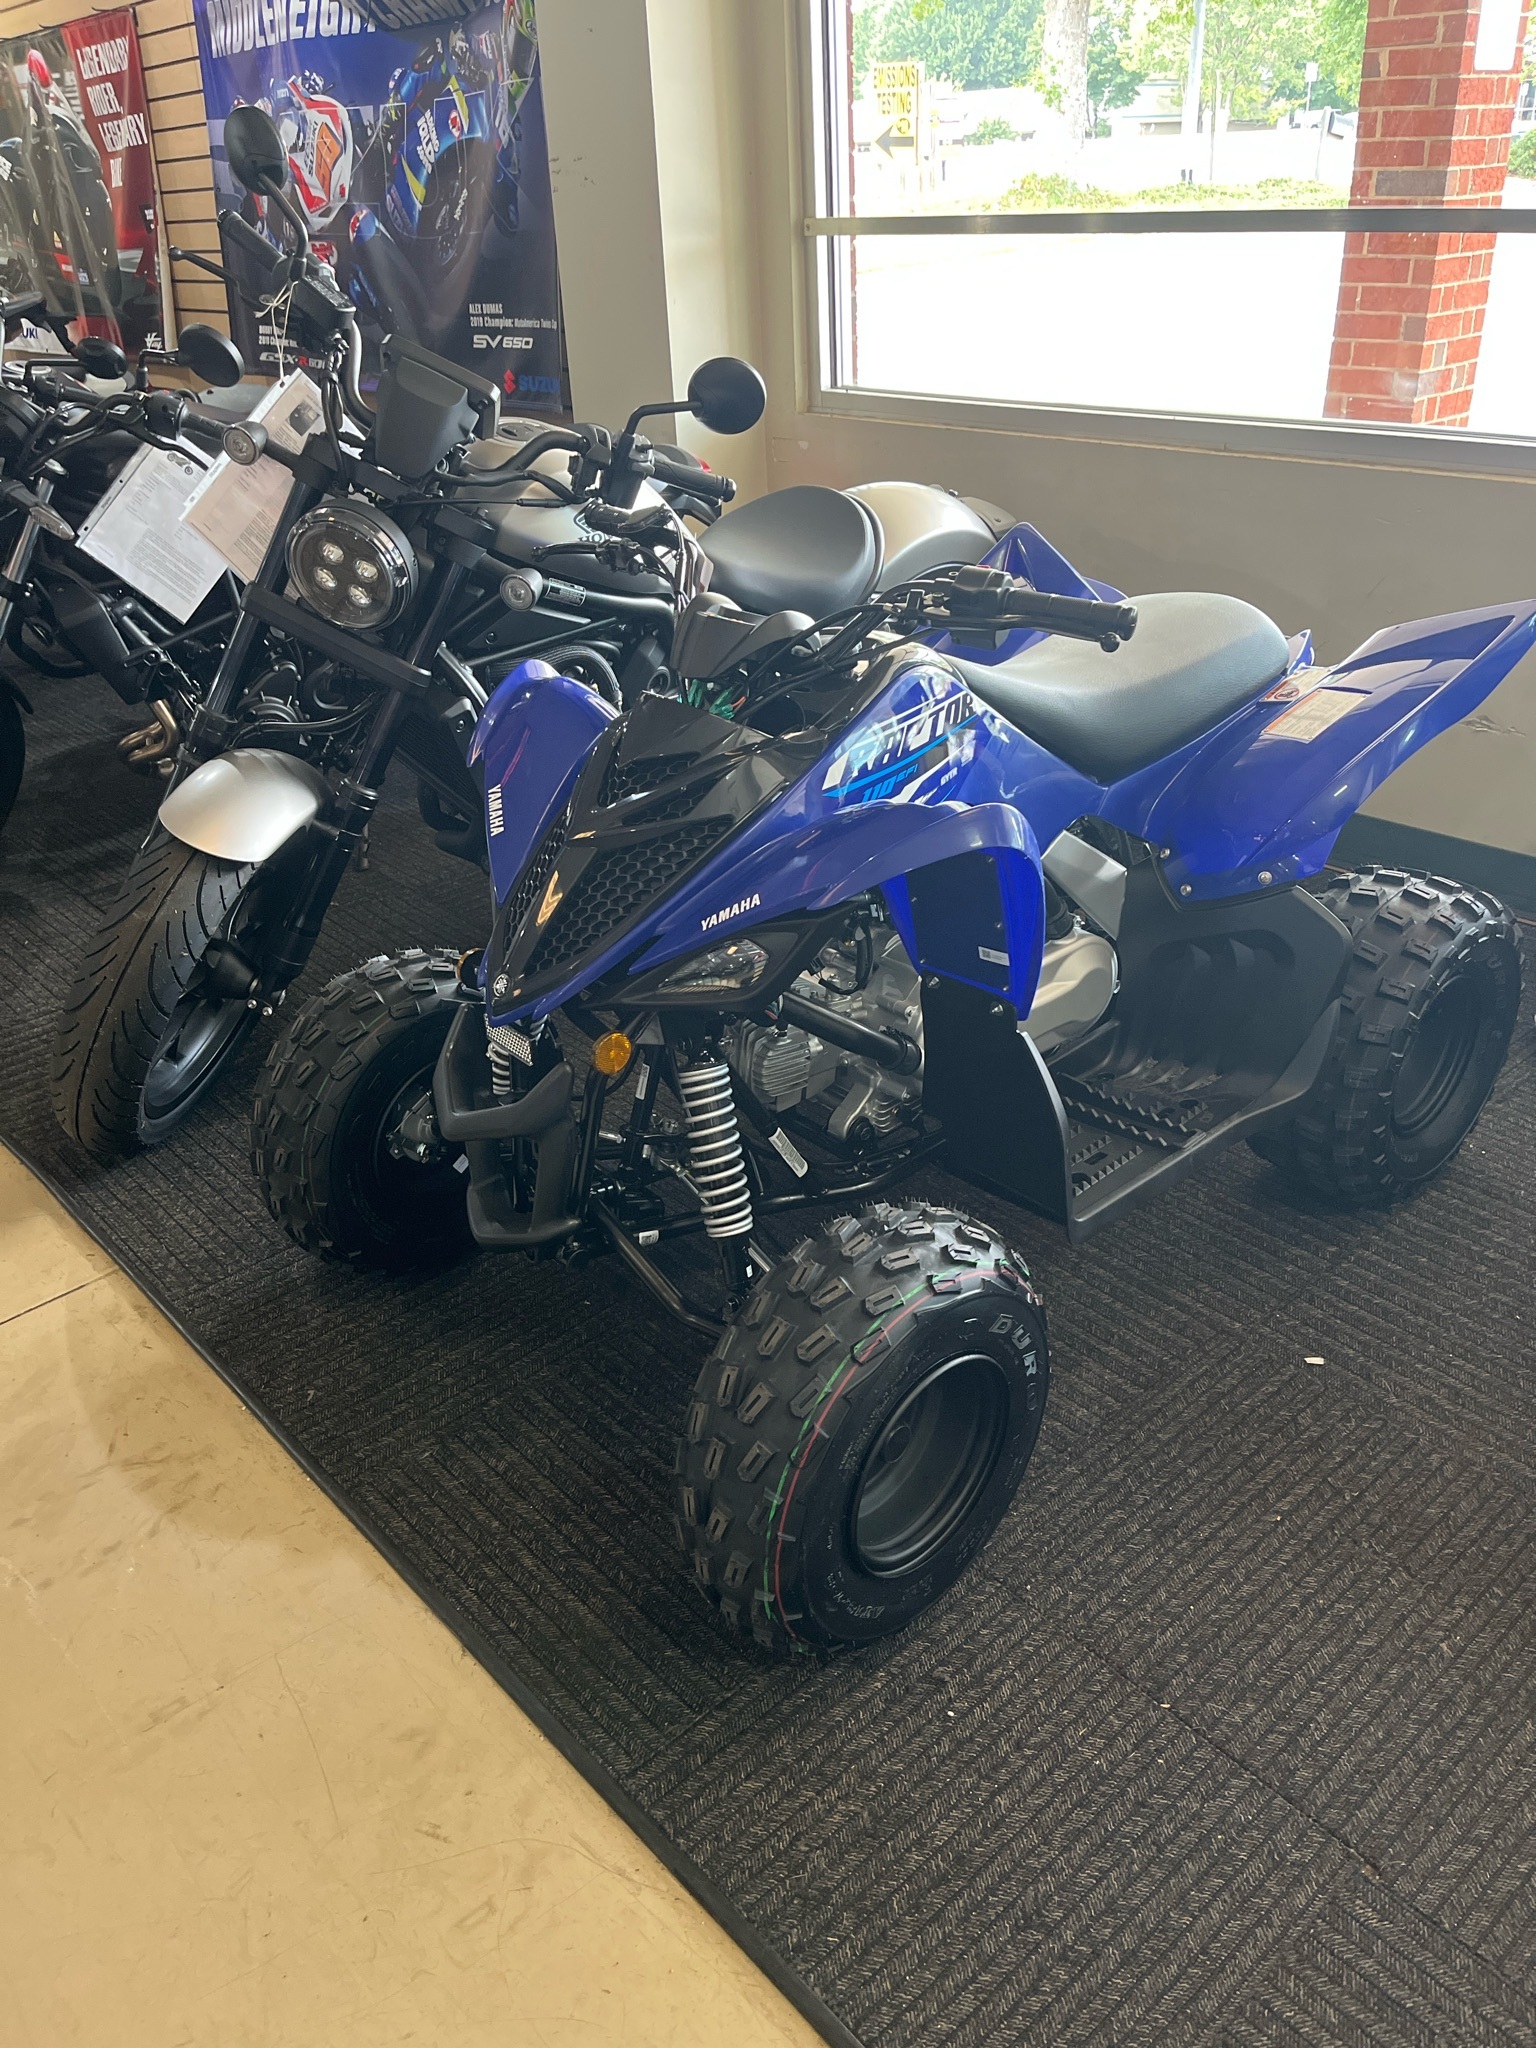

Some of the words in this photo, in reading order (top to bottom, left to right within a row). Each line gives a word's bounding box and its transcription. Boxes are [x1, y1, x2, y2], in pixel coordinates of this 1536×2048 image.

[874, 64, 915, 89] EMISSIONS
[877, 91, 911, 115] TESTING
[473, 334, 534, 349] SV650
[518, 375, 560, 394] SUZU
[487, 783, 505, 837] YAMAHA
[701, 893, 761, 931] YAMAHA
[989, 1313, 1039, 1411] DURO
